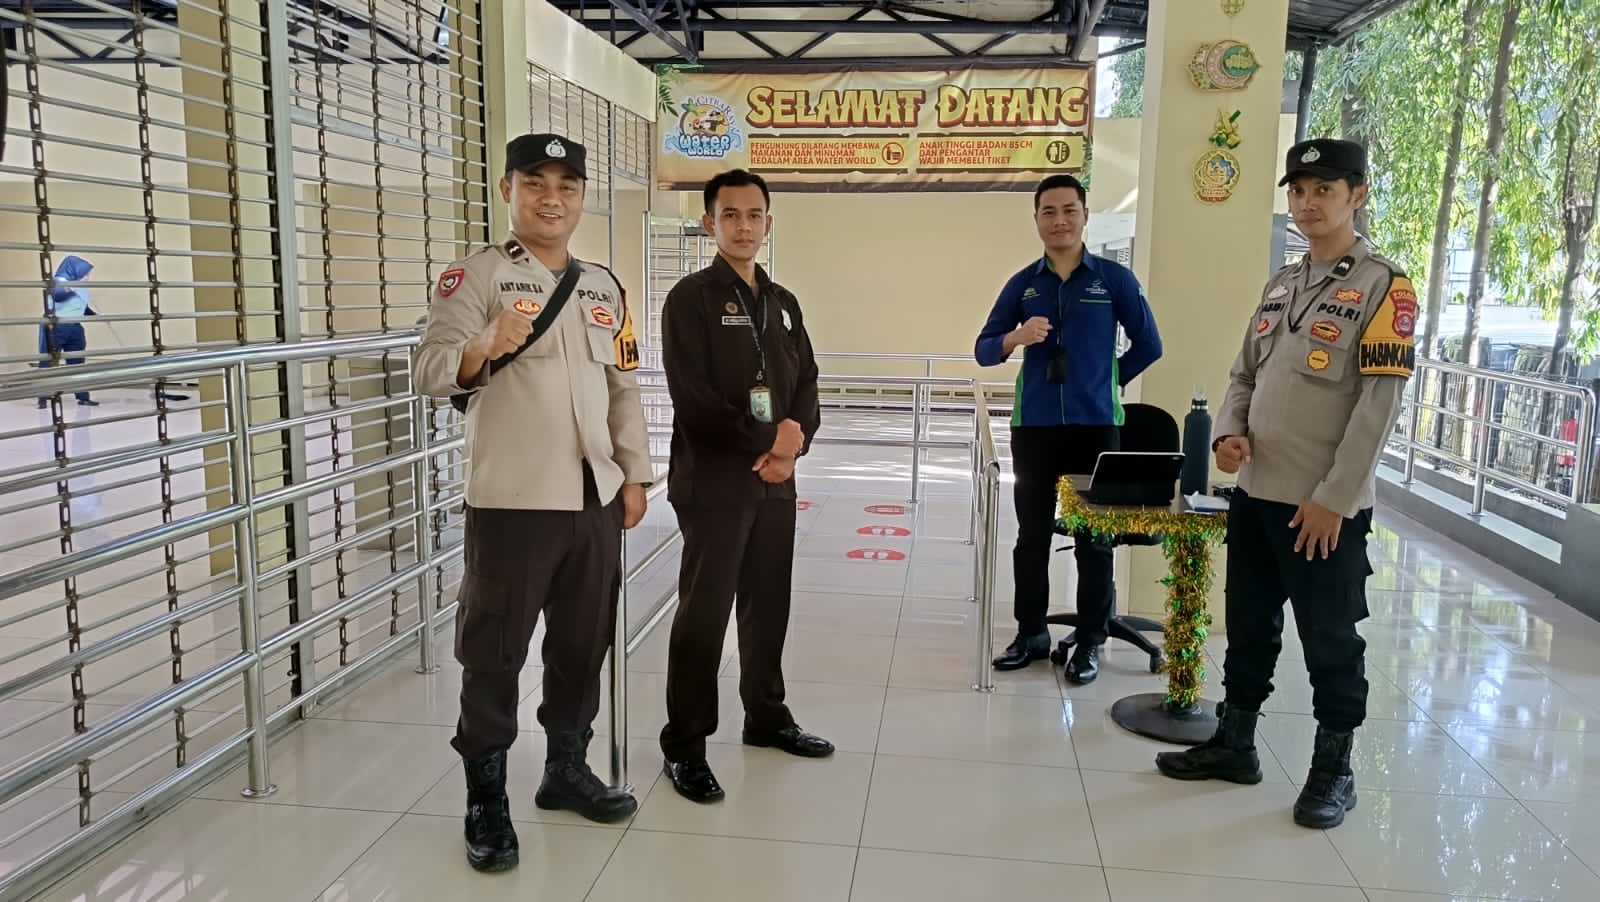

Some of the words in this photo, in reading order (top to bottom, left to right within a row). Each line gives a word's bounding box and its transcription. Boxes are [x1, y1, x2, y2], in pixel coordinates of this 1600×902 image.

[746, 86, 925, 128] SELAMAT
[936, 85, 1089, 128] DATANG
[987, 156, 1011, 164] TIKET
[577, 289, 612, 304] POLRI
[1317, 303, 1360, 321] POLRI
